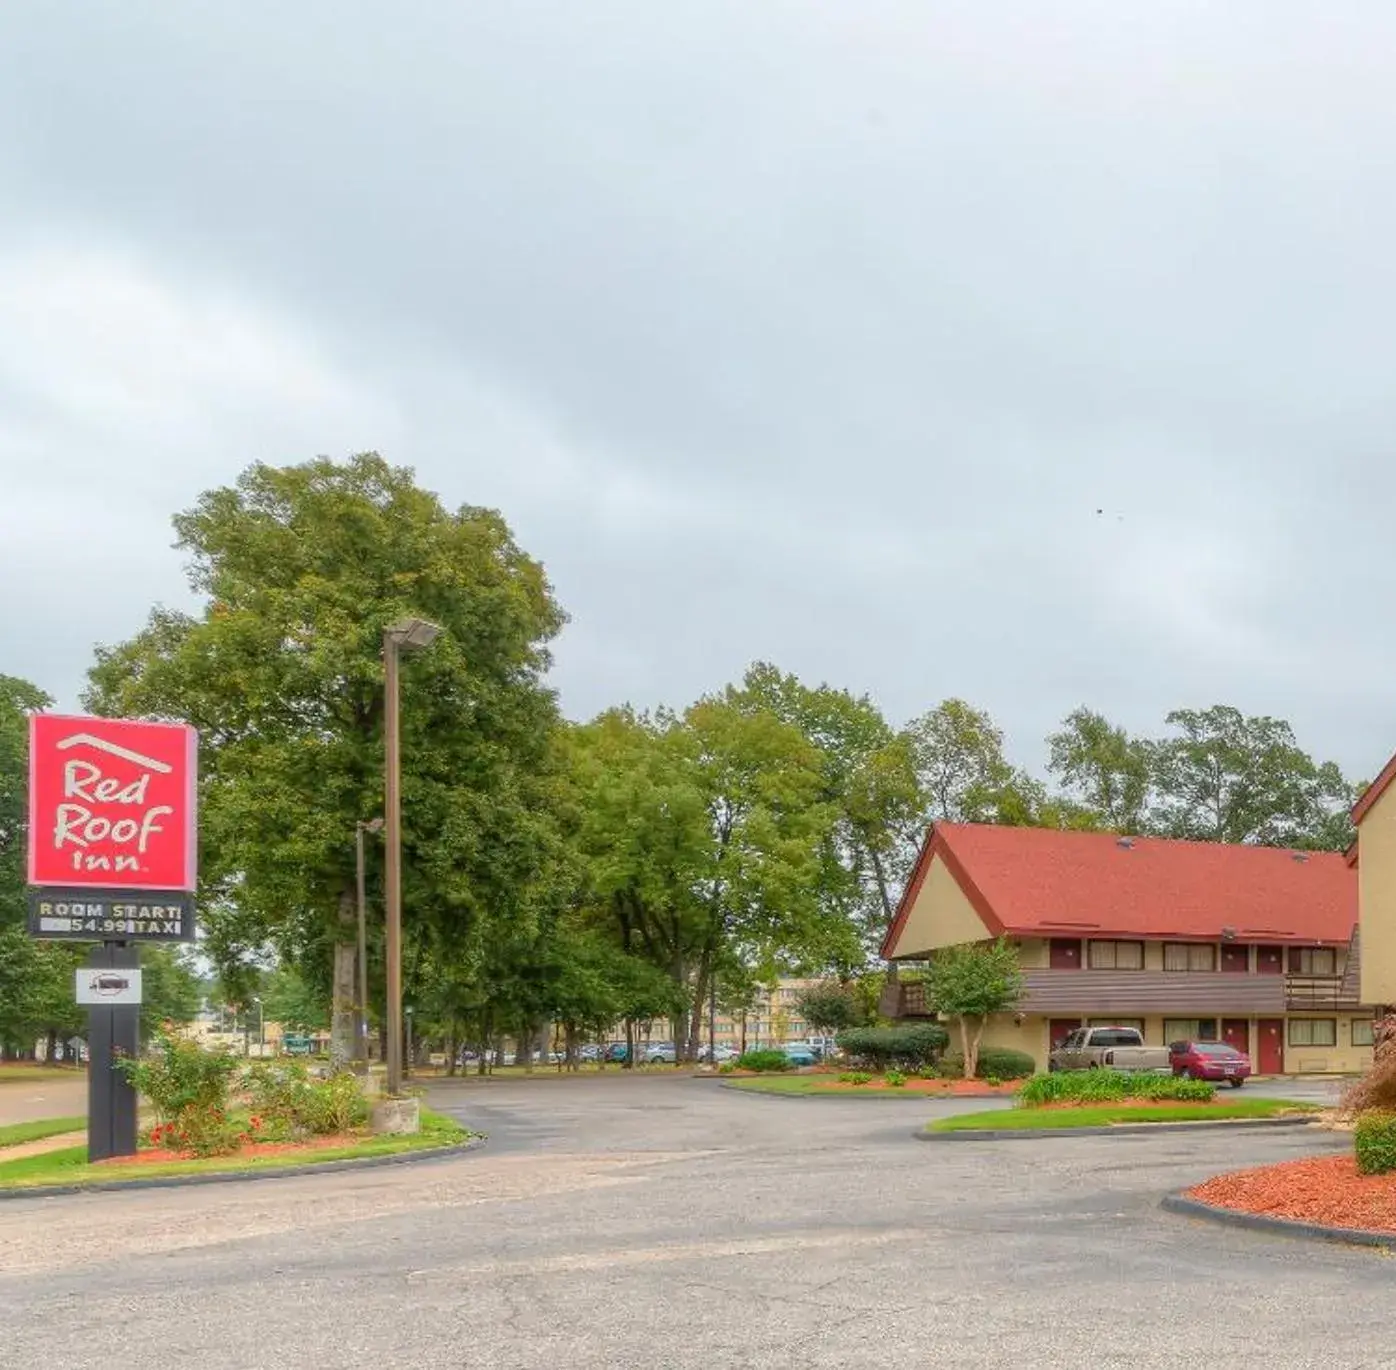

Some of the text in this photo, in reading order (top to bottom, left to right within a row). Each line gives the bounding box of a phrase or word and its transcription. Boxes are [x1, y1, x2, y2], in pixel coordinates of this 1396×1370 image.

[64, 759, 150, 804] Red
[54, 803, 173, 854] Roof
[73, 850, 139, 871] Inn
[40, 903, 103, 917] ROOM
[71, 918, 126, 932] 54.99
